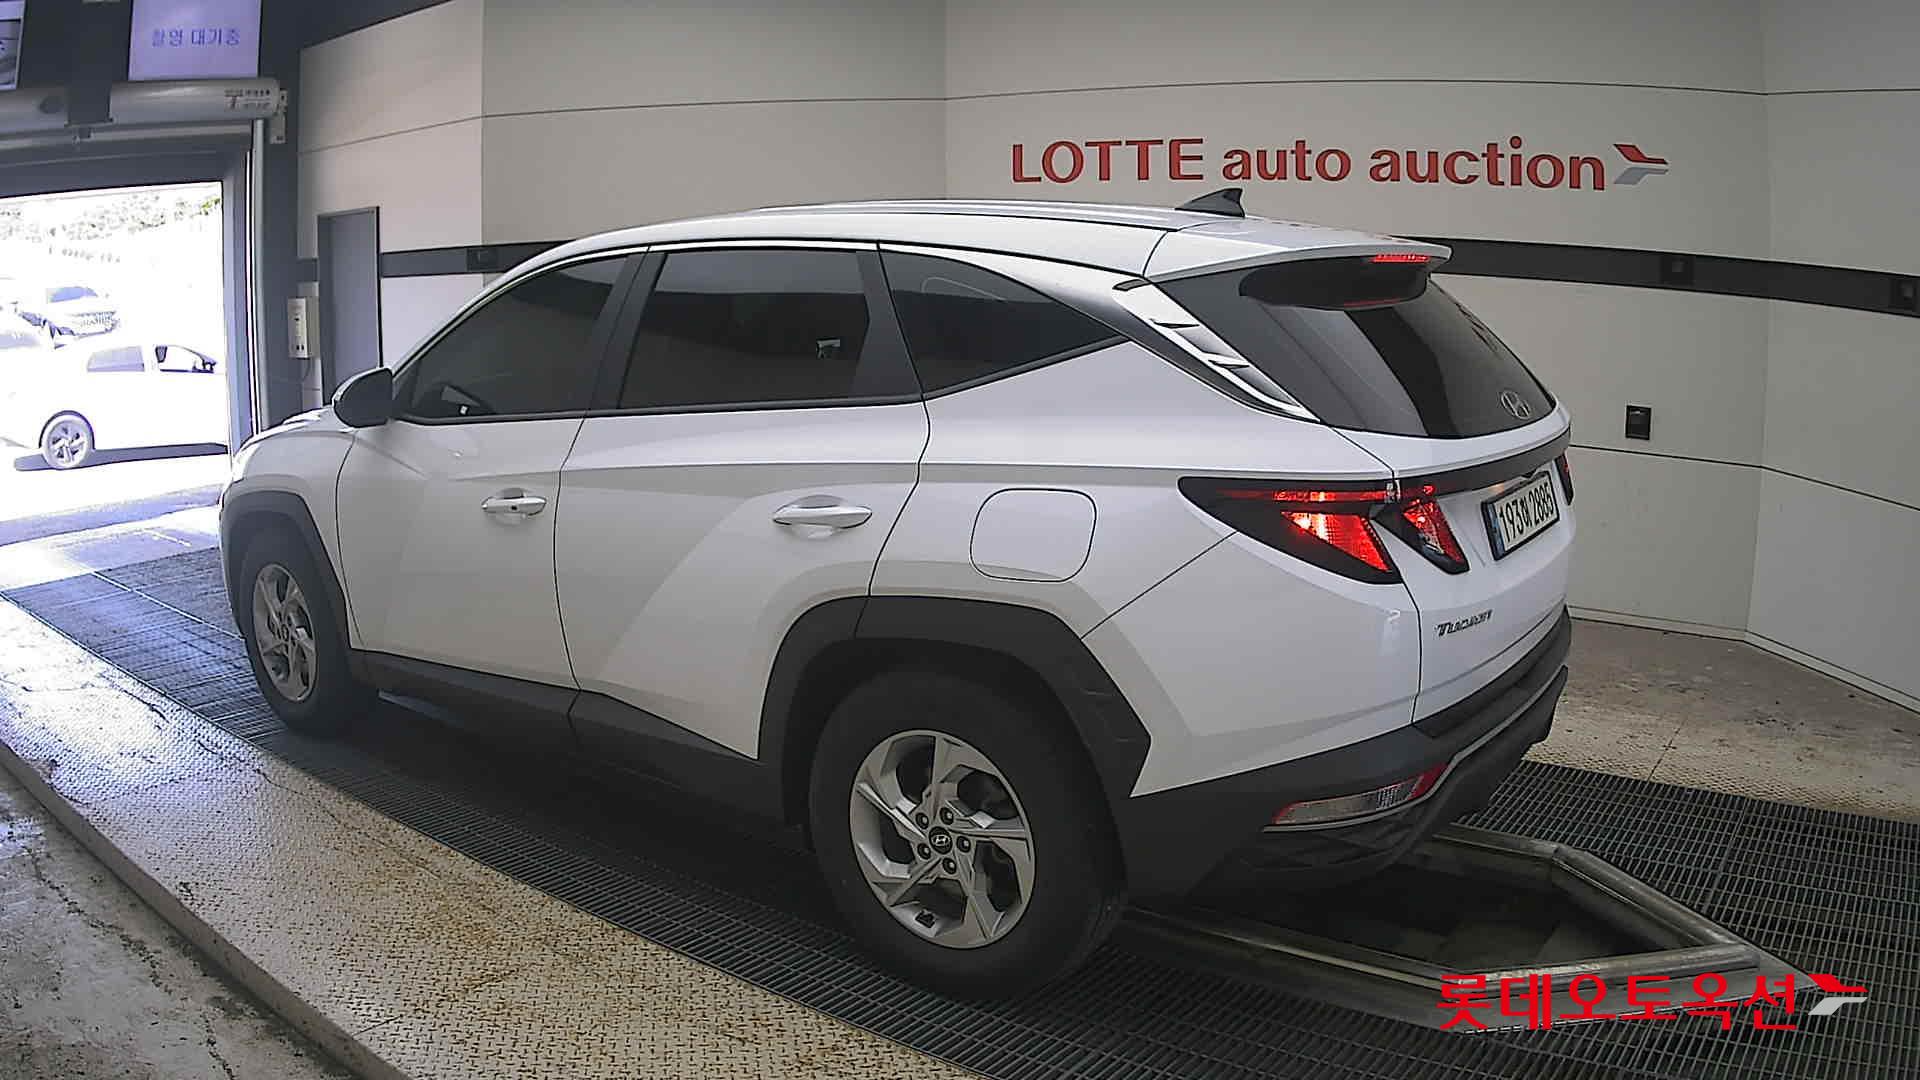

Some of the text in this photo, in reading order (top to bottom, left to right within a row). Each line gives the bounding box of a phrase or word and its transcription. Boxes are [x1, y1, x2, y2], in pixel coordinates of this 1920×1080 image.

[191, 27, 240, 47] 대기중
[1011, 135, 1606, 191] LOTTE auto auction
